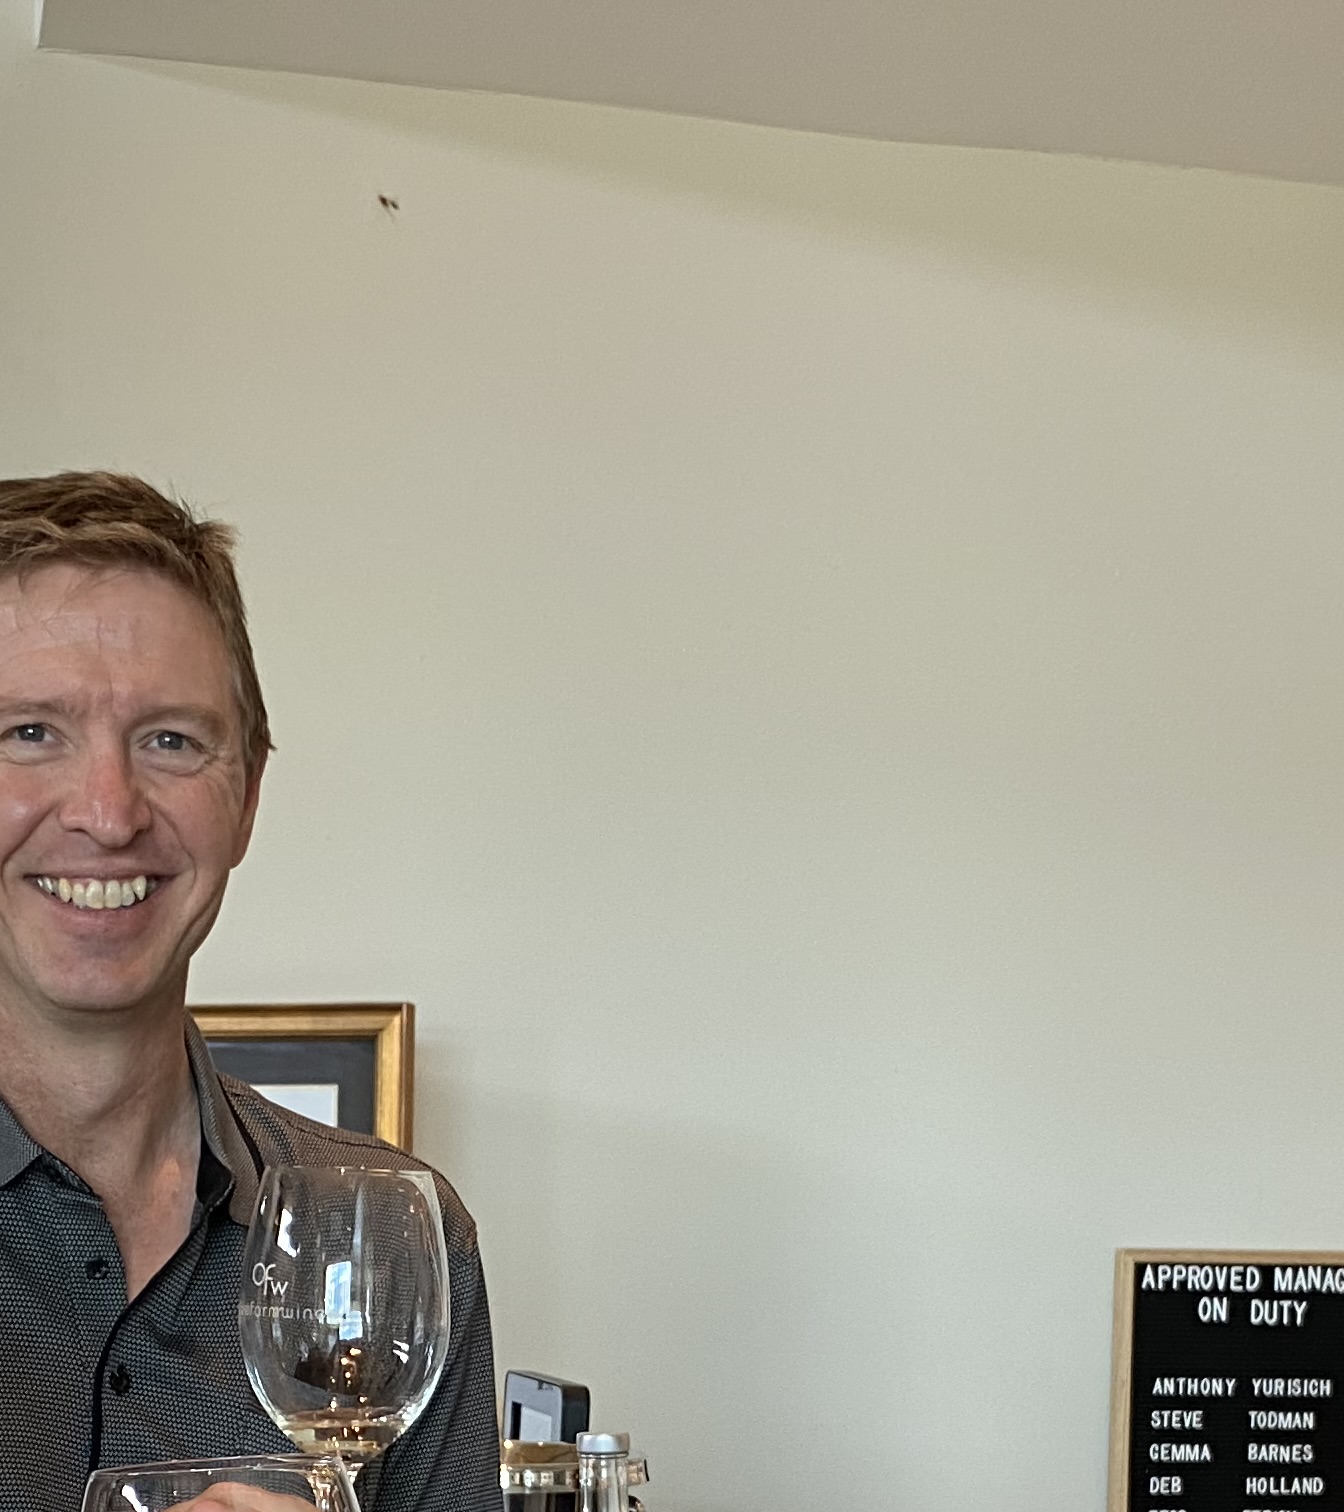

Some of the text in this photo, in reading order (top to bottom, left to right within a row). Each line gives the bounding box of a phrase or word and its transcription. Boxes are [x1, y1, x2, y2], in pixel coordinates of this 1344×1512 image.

[1141, 1263, 1260, 1293] APPROVED
[1197, 1296, 1308, 1327] ON DUTY
[1152, 1377, 1333, 1397] ANTHONY YURISICH
[1150, 1410, 1314, 1430] STEVE TODMAN
[1149, 1443, 1314, 1463] GEMMA BARNES
[1149, 1476, 1325, 1496] DEB HOLLAND
